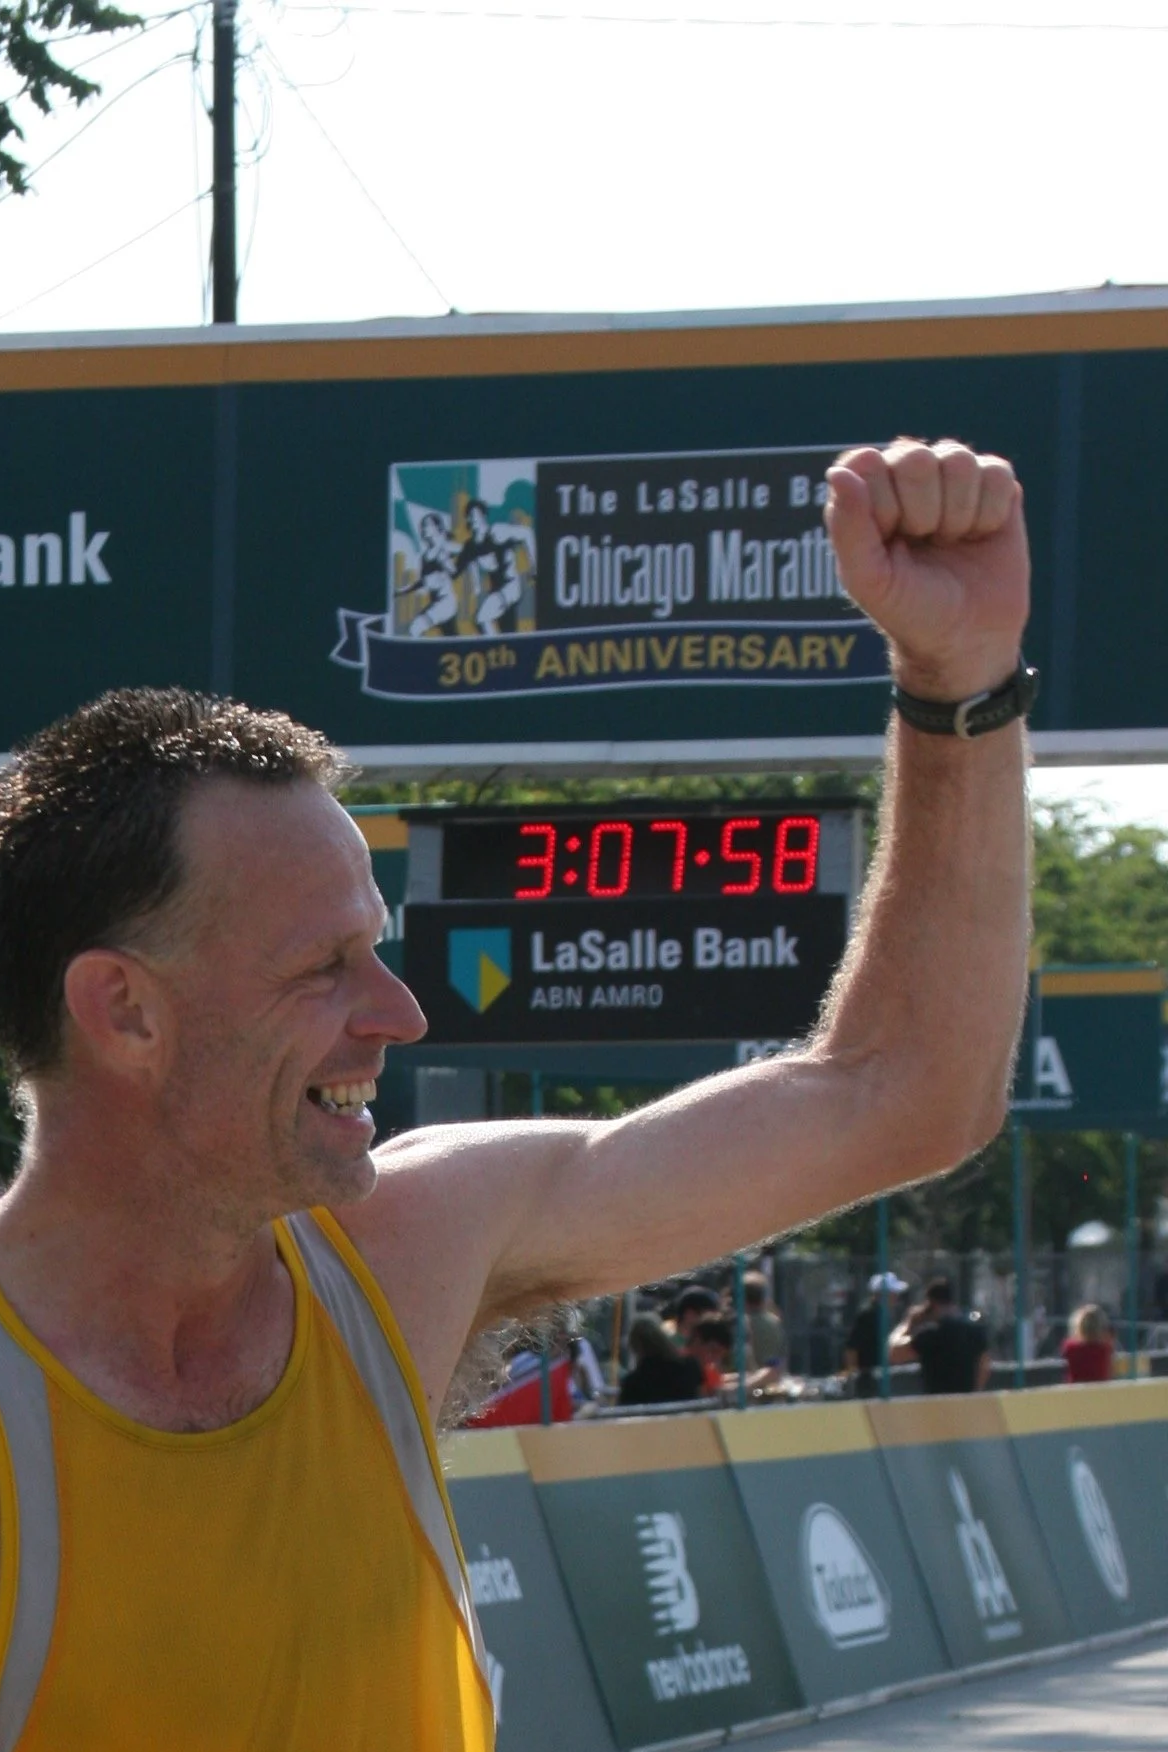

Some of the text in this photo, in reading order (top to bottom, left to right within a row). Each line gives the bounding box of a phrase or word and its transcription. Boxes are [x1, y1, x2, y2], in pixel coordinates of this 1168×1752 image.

[556, 474, 833, 516] The LaSalle Ba
[554, 526, 846, 619] Chicago Marath
[438, 635, 857, 687] 30th ANNIVERSARY
[531, 925, 800, 973] LaSalle Bank
[531, 984, 665, 1009] ABN AMRO
